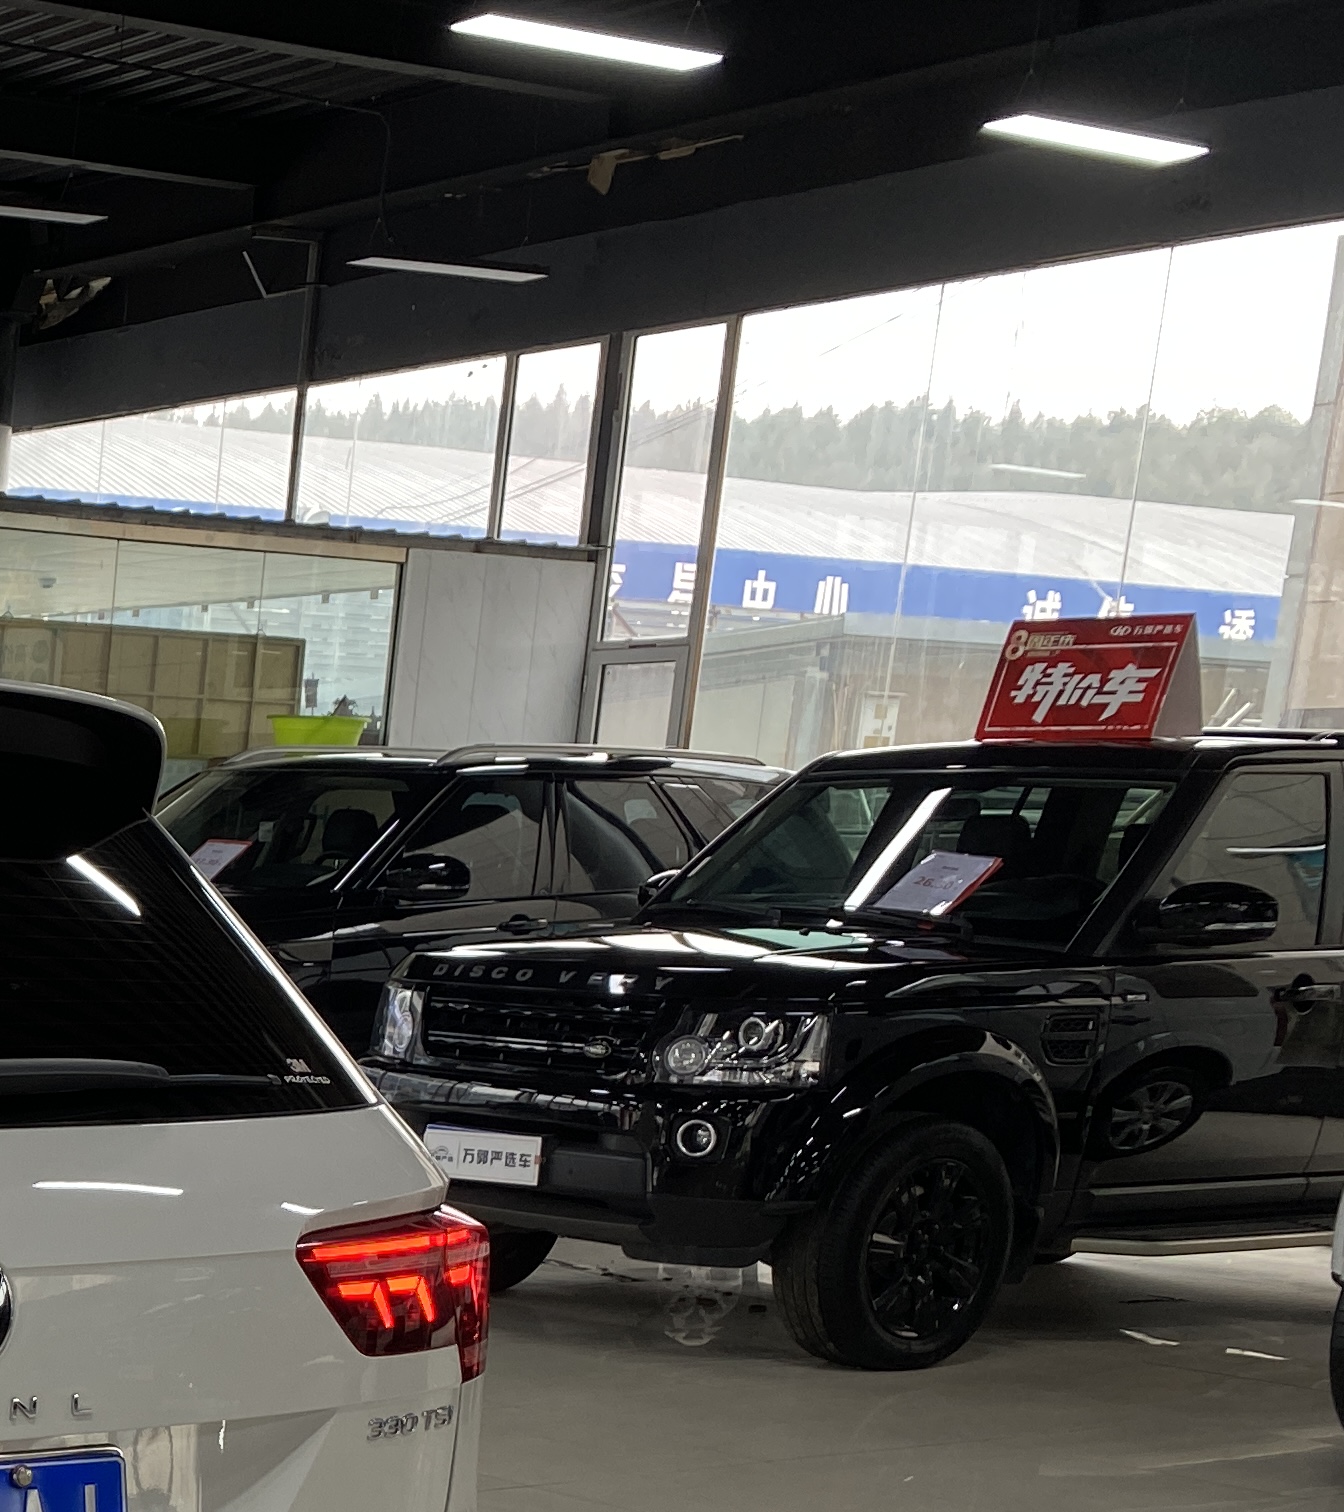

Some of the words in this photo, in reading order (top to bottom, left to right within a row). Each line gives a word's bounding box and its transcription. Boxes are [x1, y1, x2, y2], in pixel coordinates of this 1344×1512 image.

[1011, 662, 1162, 724] 特价车
[70, 1392, 95, 1417] L
